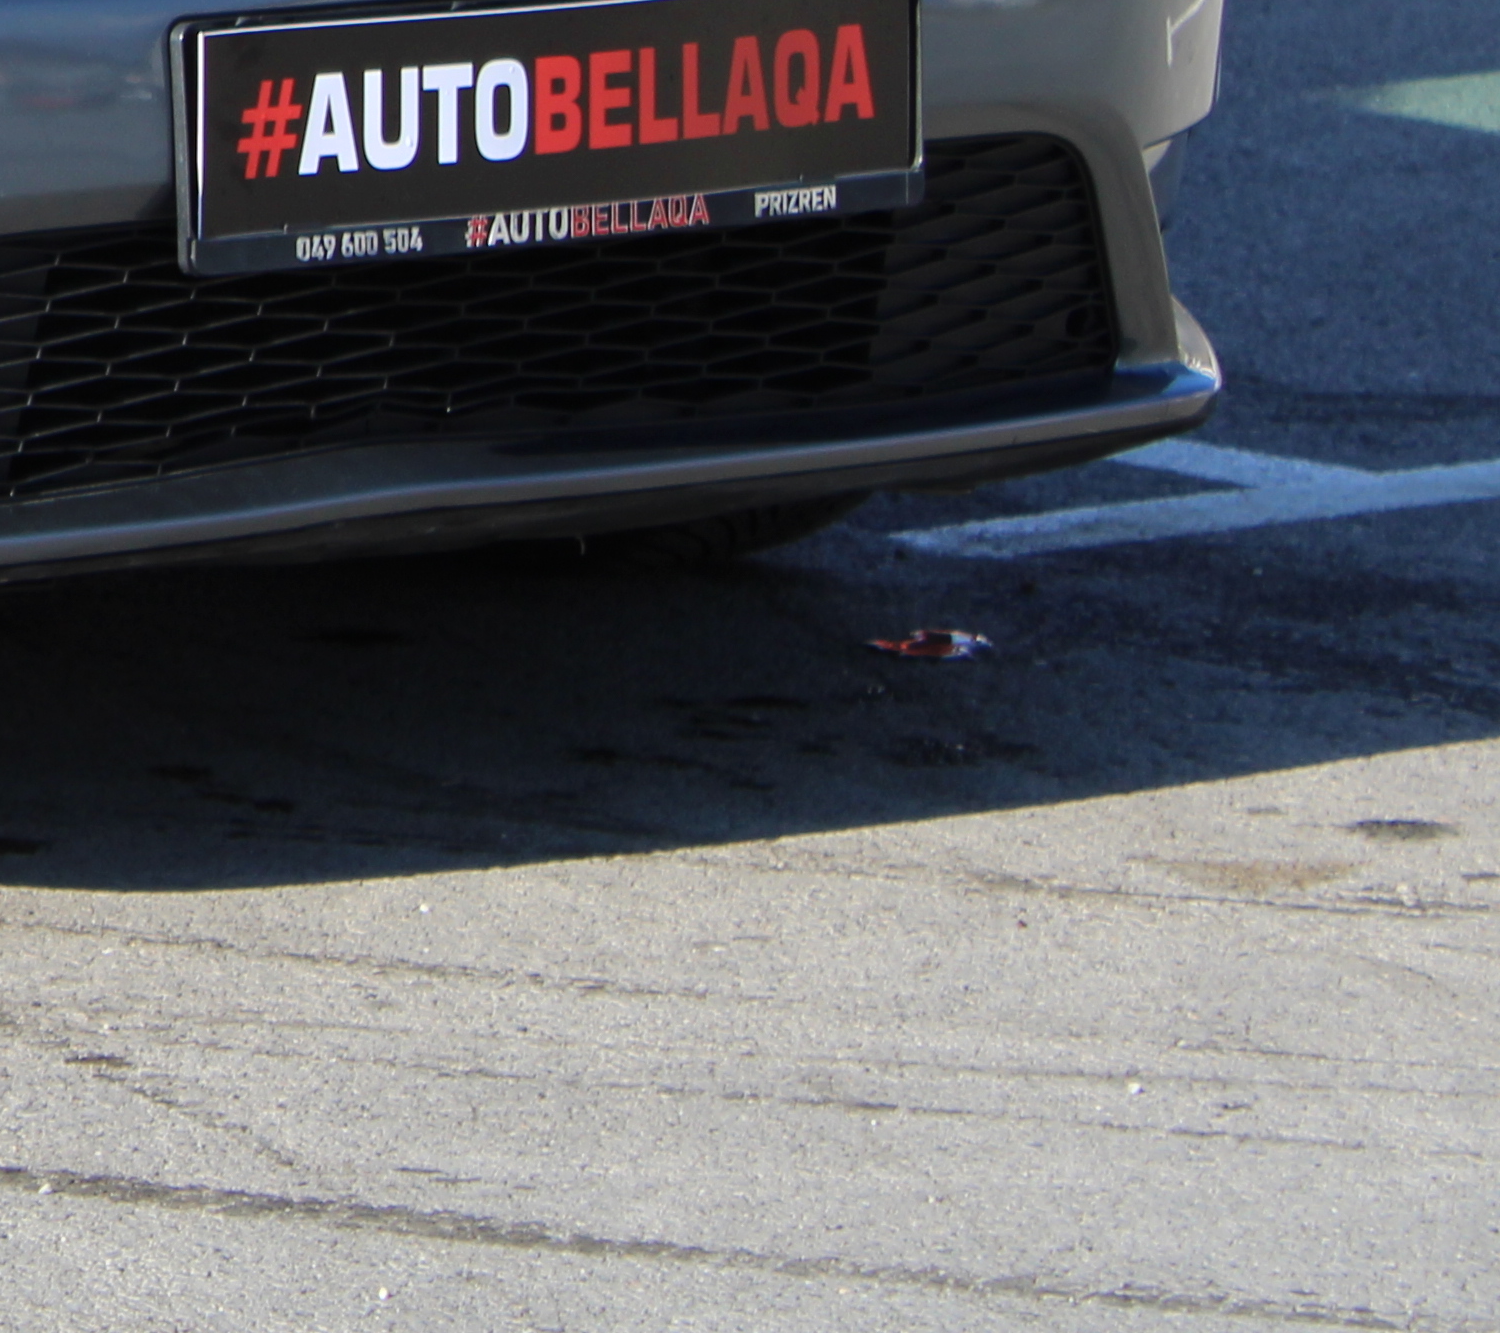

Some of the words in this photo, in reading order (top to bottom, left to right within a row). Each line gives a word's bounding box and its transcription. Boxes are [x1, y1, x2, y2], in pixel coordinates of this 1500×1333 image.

[236, 23, 876, 180] #AUTOBELLAQA
[296, 235, 336, 263] 049
[341, 231, 379, 259] 600
[383, 226, 424, 255] 504
[754, 185, 838, 219] PRIZREN
